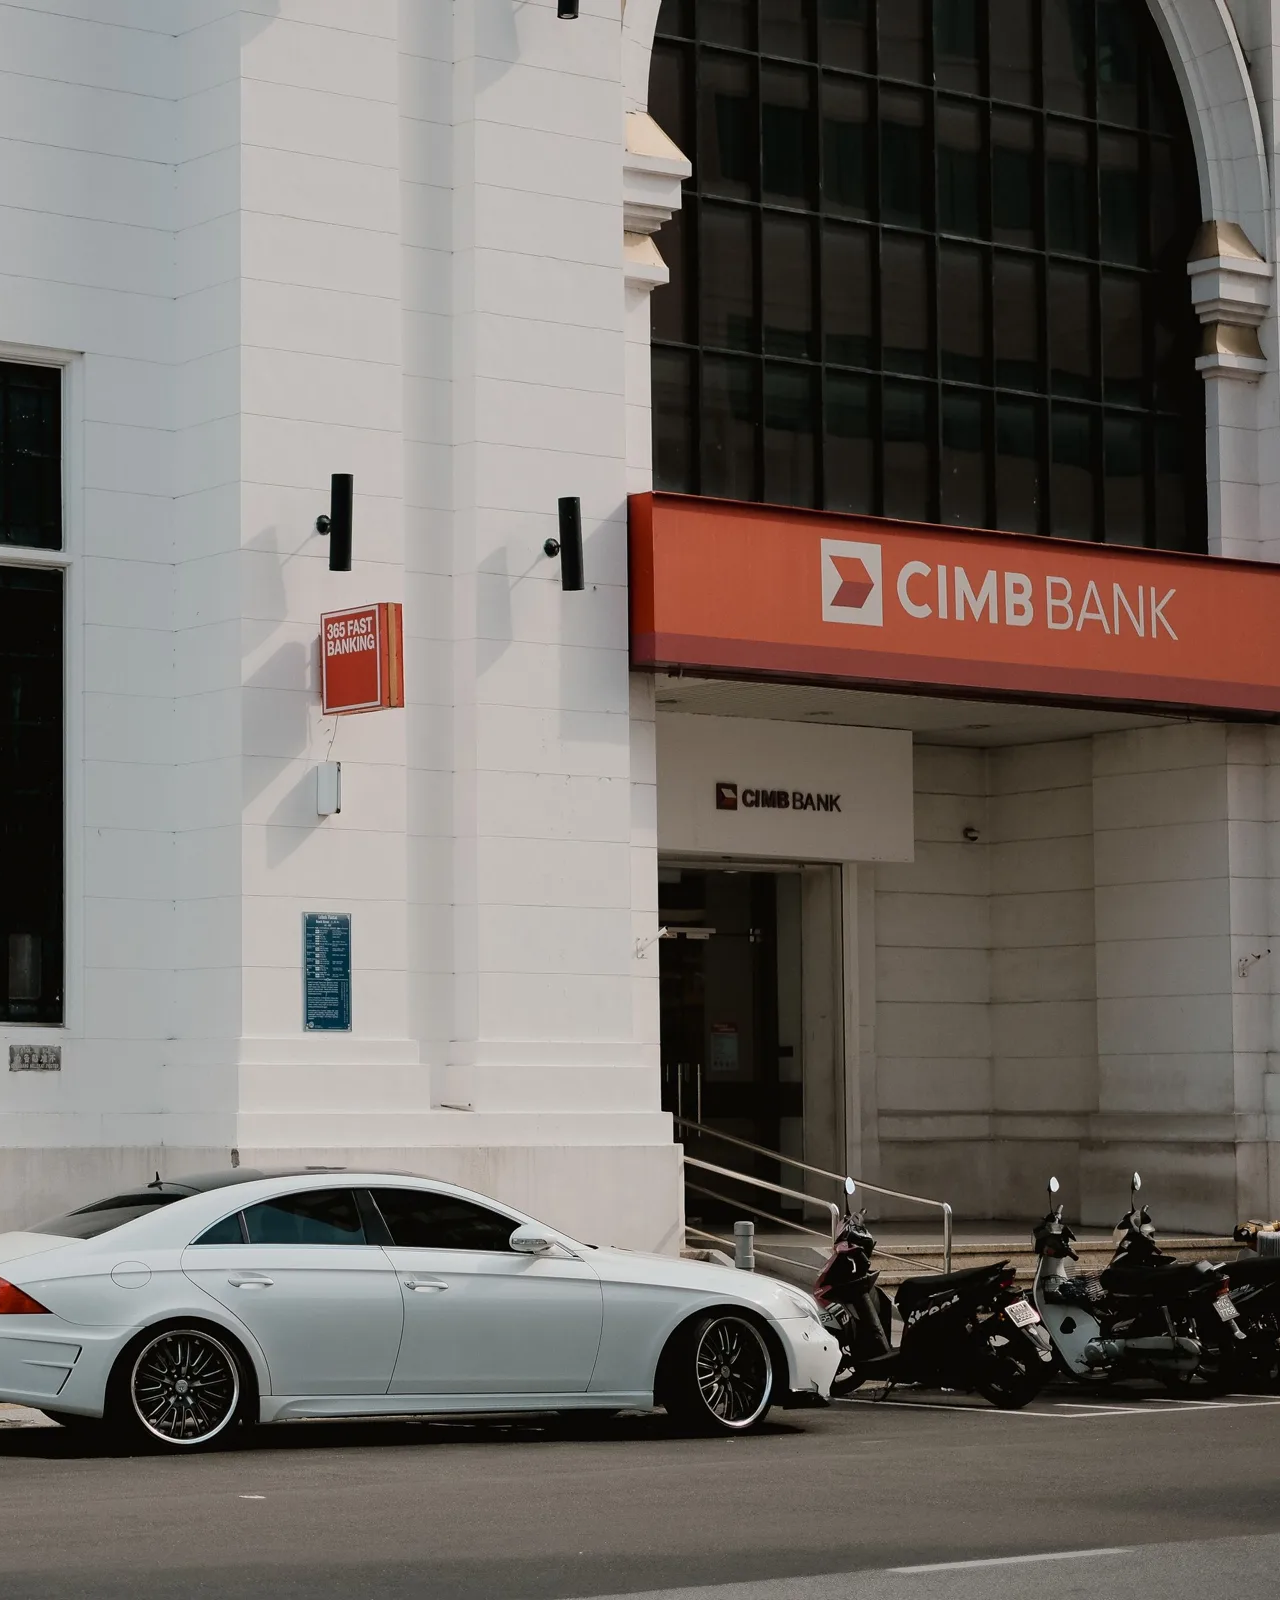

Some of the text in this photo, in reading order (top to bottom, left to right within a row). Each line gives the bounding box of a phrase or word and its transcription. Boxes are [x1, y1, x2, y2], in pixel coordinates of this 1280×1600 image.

[896, 560, 1179, 641] CIMB BANK
[327, 616, 373, 640] 365 FAST
[327, 633, 375, 657] BANKING
[741, 788, 842, 813] CIMB BANK
